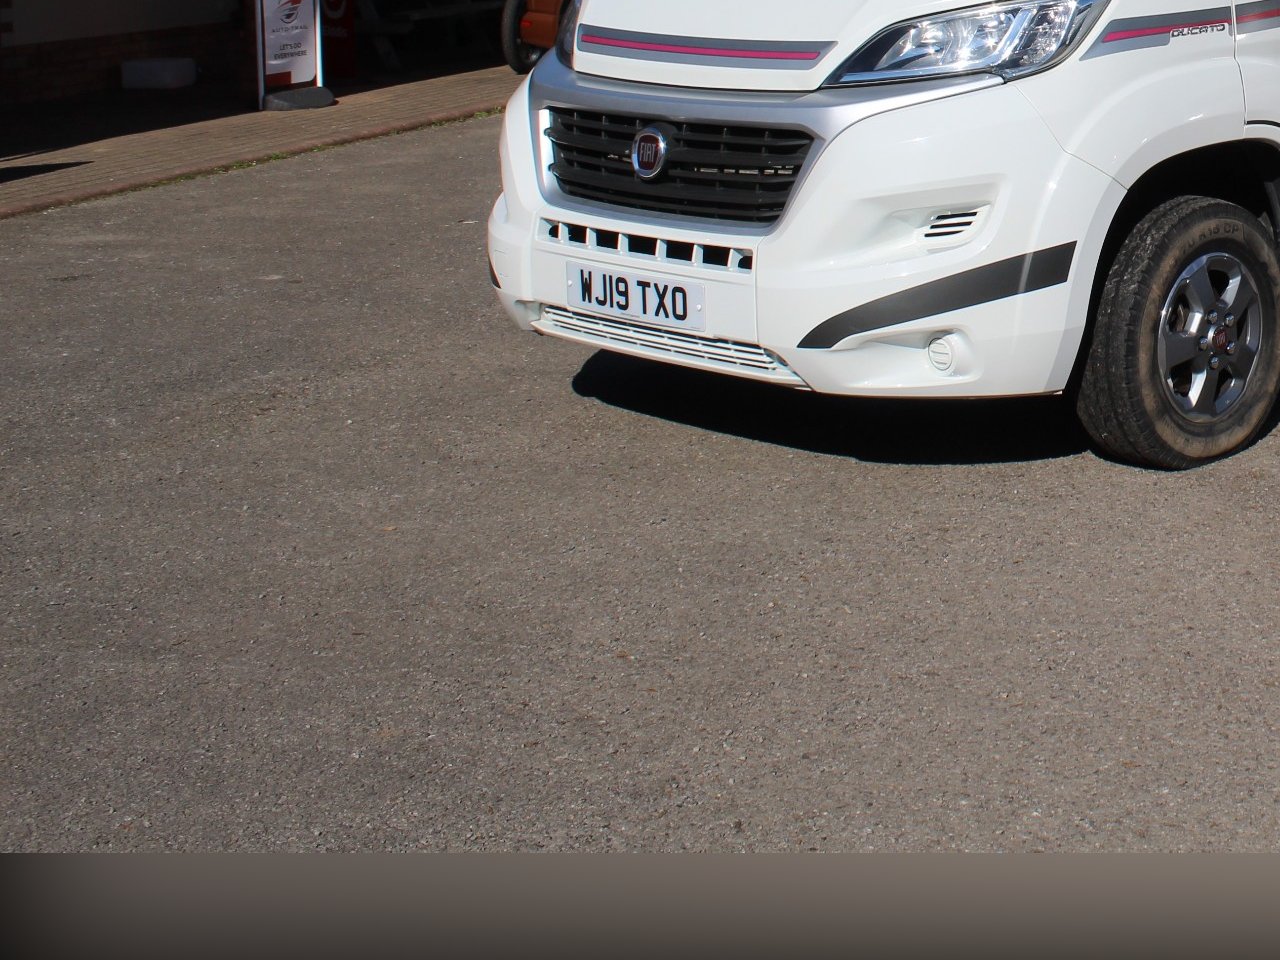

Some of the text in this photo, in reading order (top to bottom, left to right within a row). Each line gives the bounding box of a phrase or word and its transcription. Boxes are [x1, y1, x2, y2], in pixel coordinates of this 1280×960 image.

[1171, 23, 1226, 38] DUCATO
[640, 142, 656, 163] FIAT
[580, 268, 688, 321] WJ19 TXO
